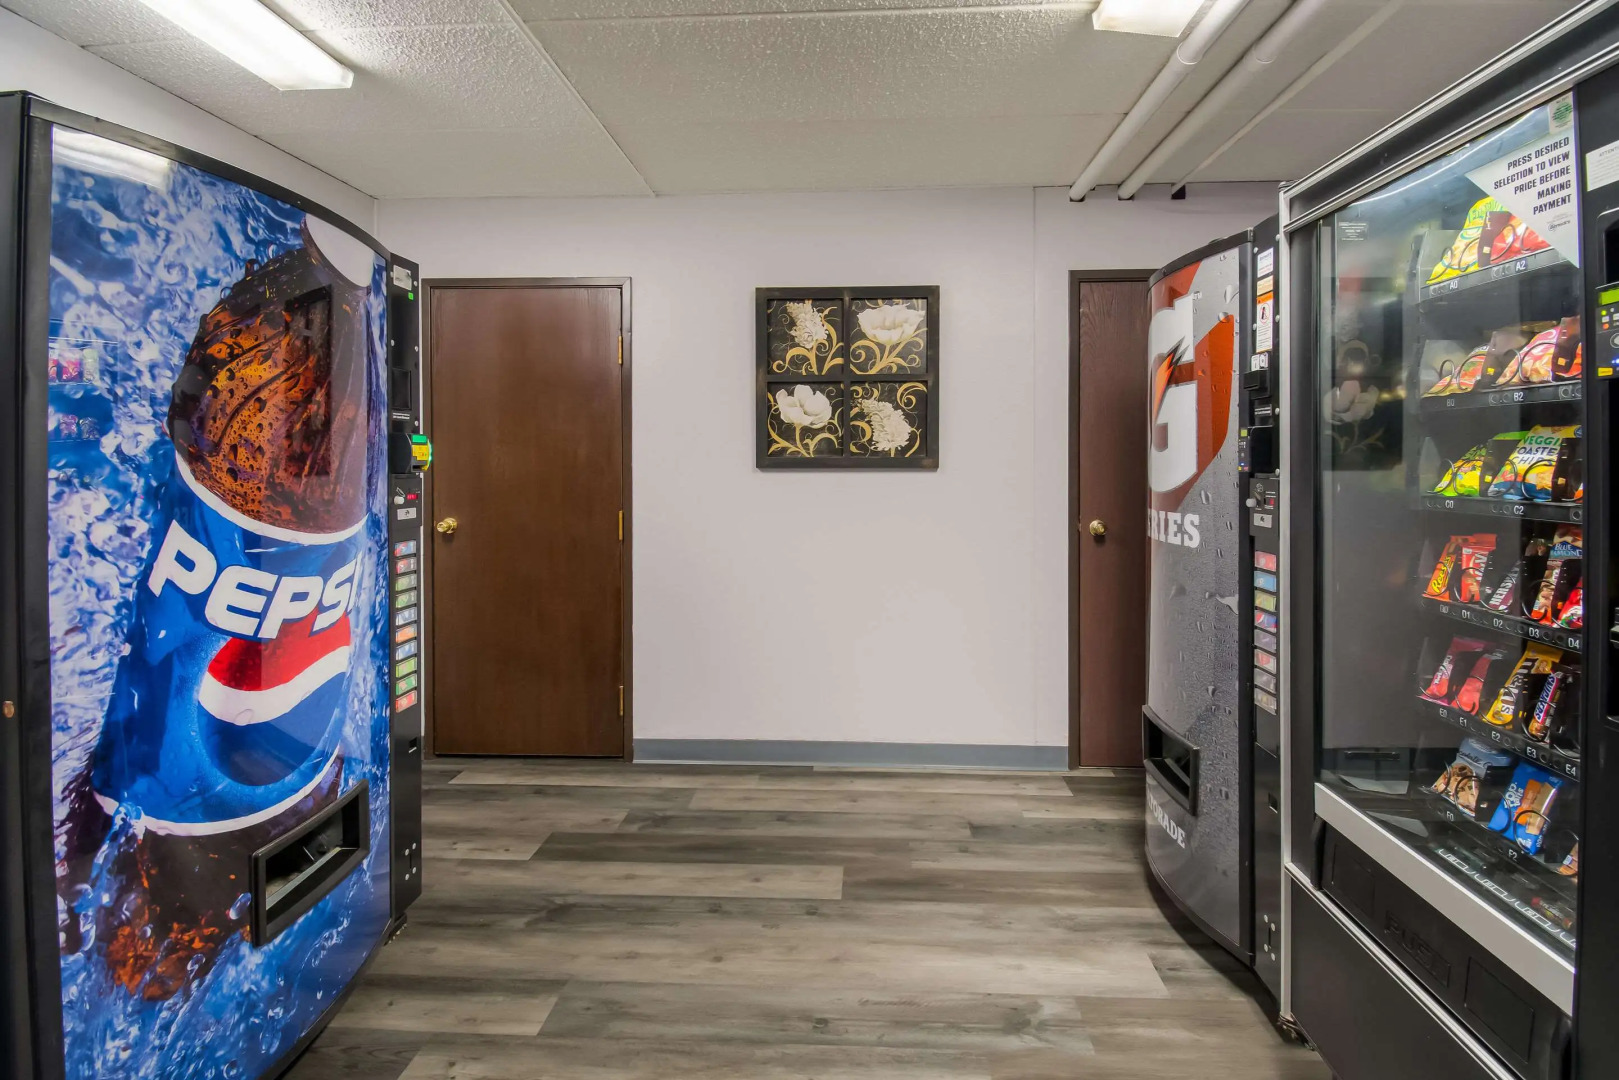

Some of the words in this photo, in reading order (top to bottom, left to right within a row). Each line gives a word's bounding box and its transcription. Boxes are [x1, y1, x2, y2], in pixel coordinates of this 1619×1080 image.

[1507, 153, 1532, 171] PRESS
[1534, 136, 1570, 159] DESIRED
[1494, 166, 1533, 190] SELECTION
[1536, 161, 1546, 173] TO
[1548, 150, 1571, 167] VIEW
[1514, 178, 1537, 195] PRICE
[1539, 165, 1571, 185] BEFORE
[1537, 180, 1571, 200] MAKING
[1533, 194, 1572, 215] PAYMENT
[1515, 261, 1526, 271] A2
[1513, 392, 1524, 401] B2
[1523, 435, 1561, 446] VEGGI
[1513, 505, 1524, 515] C2
[148, 519, 362, 639] PEPSI
[1491, 732, 1501, 742] E2
[1526, 746, 1537, 758] E3
[1565, 764, 1576, 776] E4
